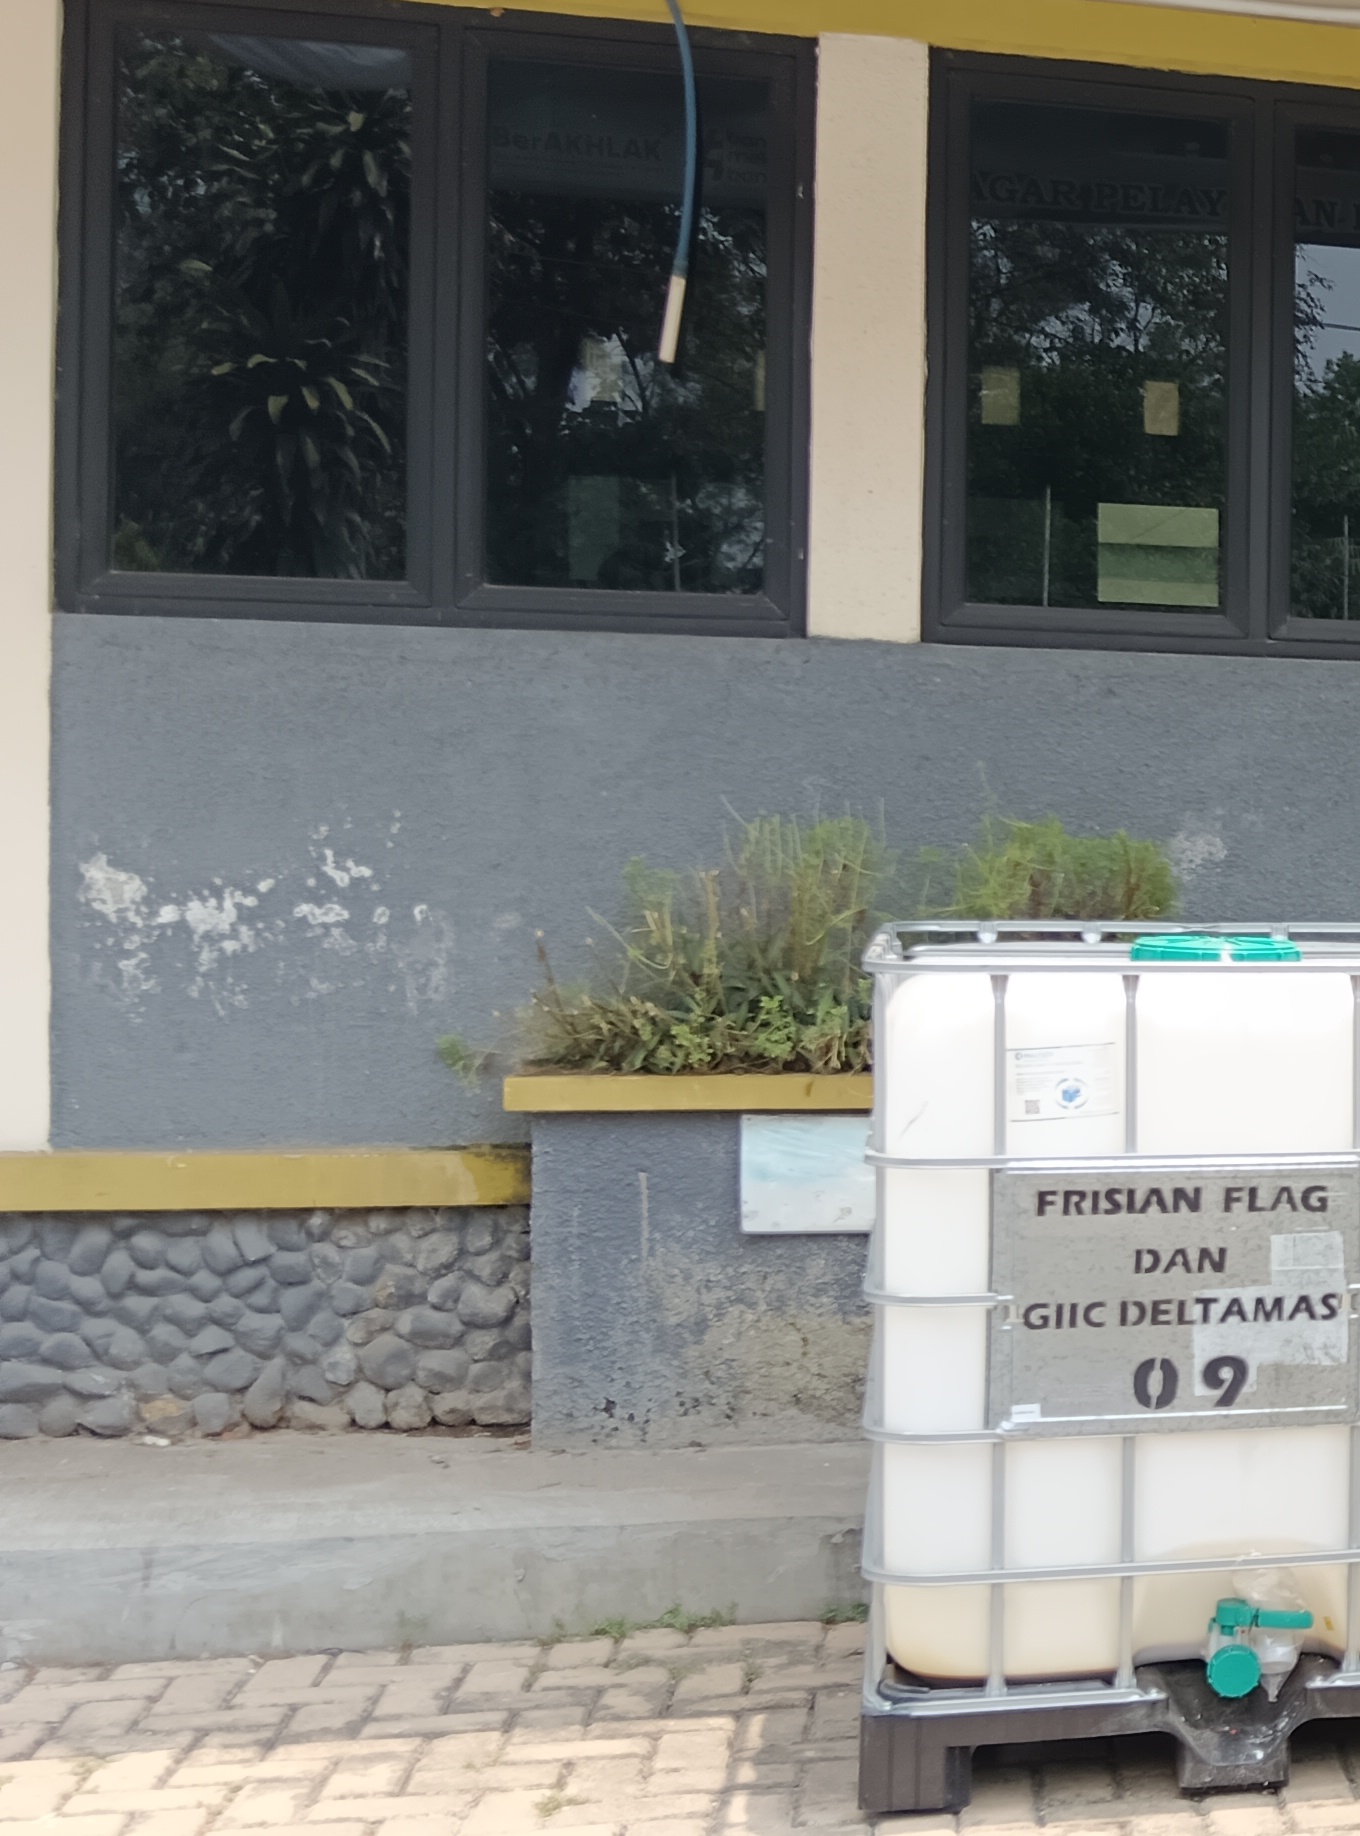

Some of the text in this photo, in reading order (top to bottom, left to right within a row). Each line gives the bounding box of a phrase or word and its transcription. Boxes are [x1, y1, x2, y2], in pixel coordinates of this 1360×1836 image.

[1036, 1185, 1329, 1216] FRISIAN FLAG
[1134, 1247, 1228, 1274] DAN
[1023, 1293, 1340, 1330] GIIC DELTAMAS
